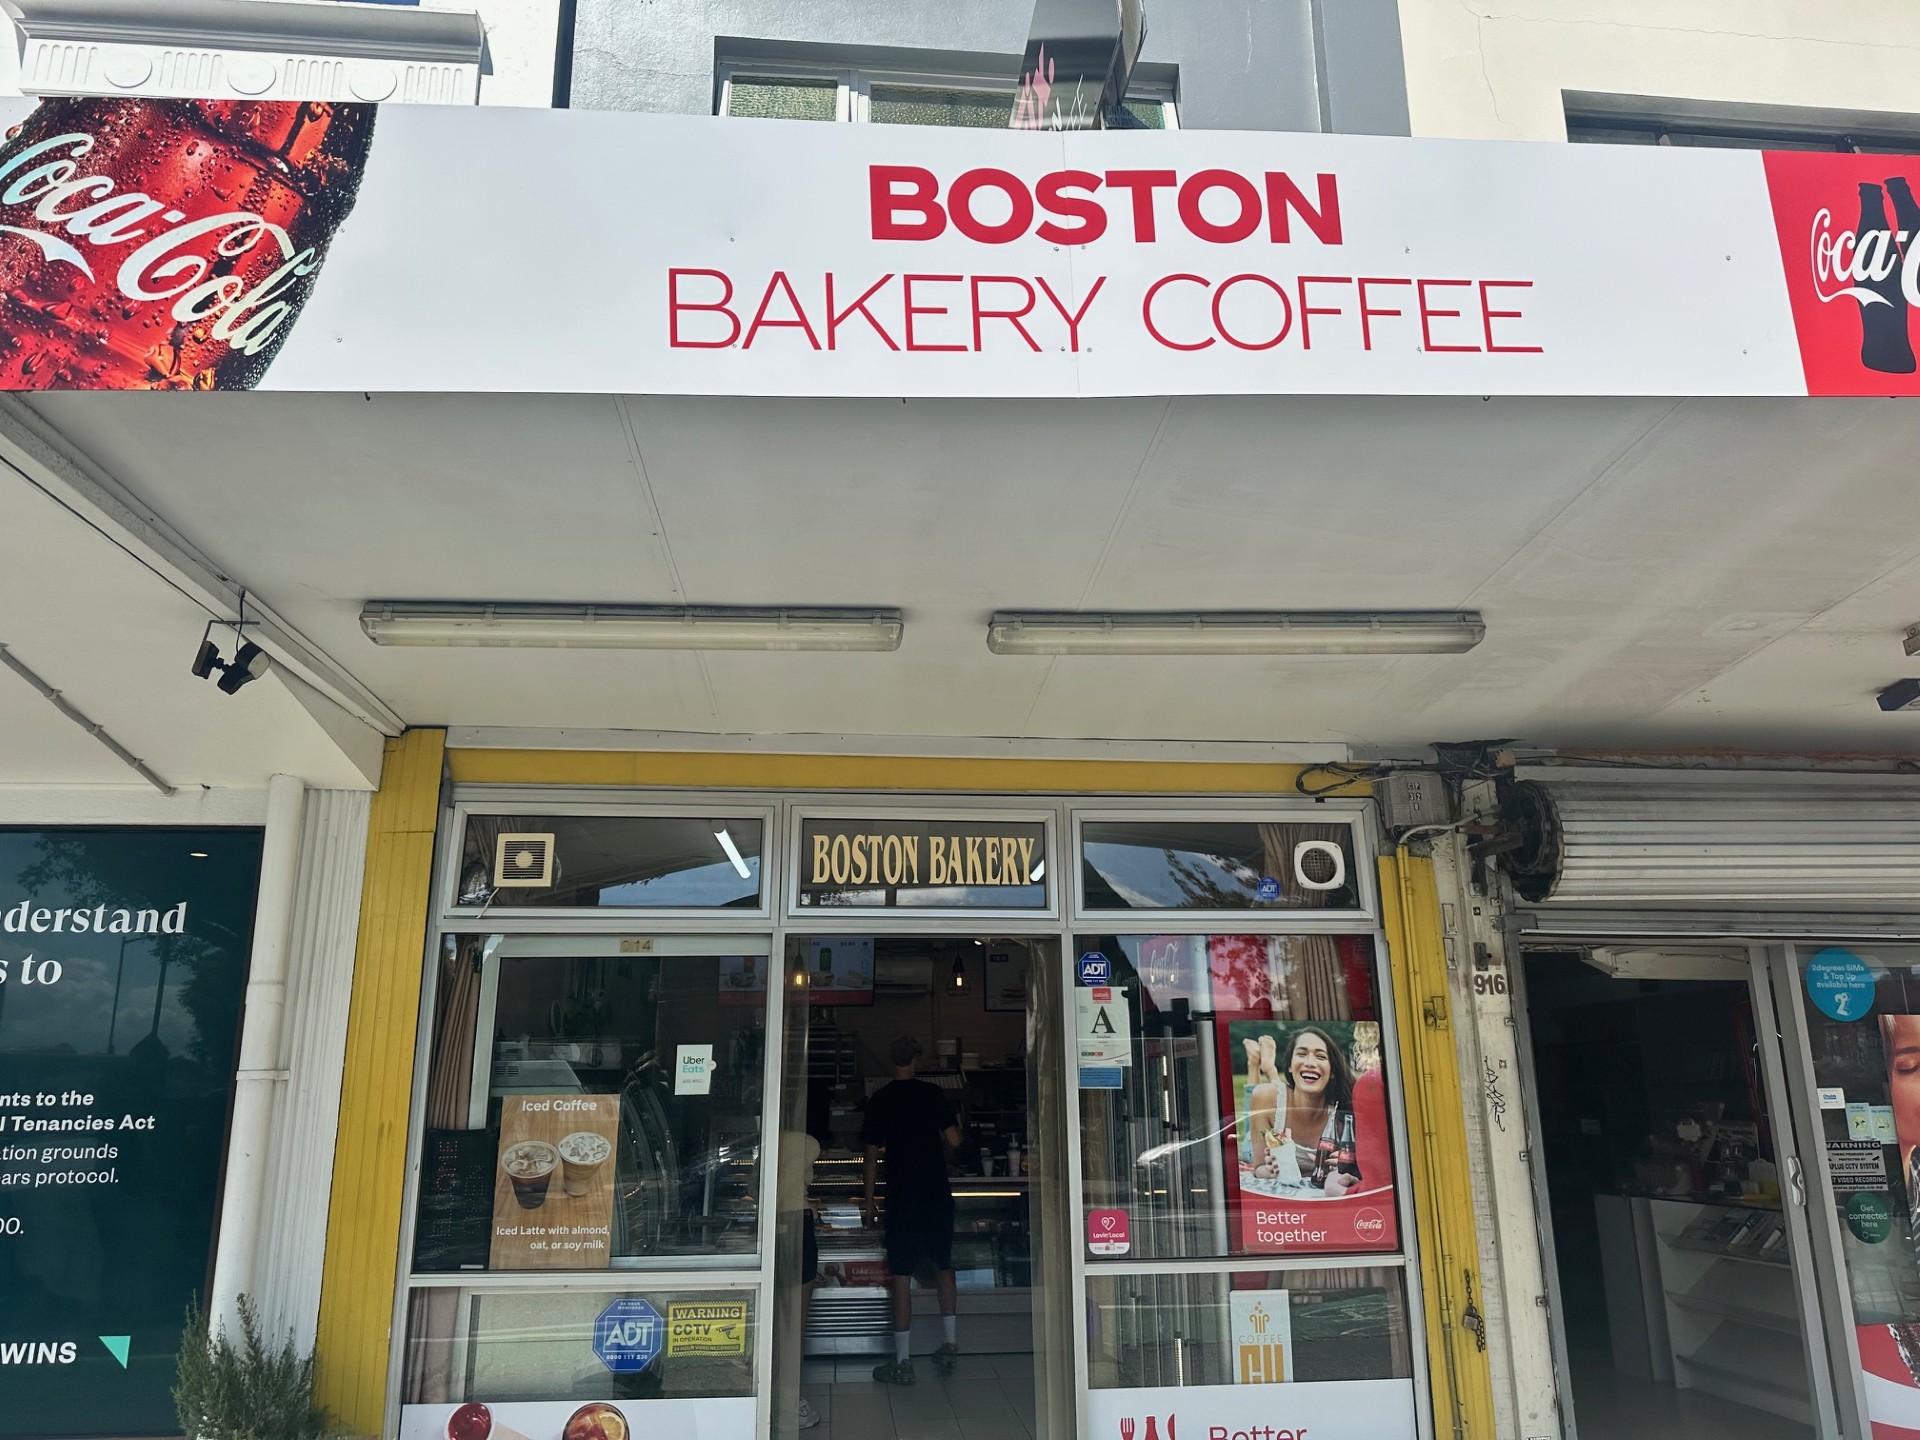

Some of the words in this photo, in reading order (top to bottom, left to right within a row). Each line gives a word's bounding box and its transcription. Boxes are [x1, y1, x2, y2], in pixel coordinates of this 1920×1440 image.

[868, 164, 1343, 246] BOSTON
[0, 132, 318, 356] Coca-Cola
[667, 267, 1107, 352] BAKERY
[1141, 273, 1545, 353] COFFEE
[812, 834, 919, 885] BOSTON
[929, 836, 1035, 886] BAKERY
[1260, 884, 1276, 893] ADT
[0, 900, 187, 934] derstand
[21, 953, 63, 985] to
[1083, 963, 1106, 975] ADT
[1812, 964, 1845, 972] 2degrees
[1830, 973, 1844, 982] Top
[1845, 973, 1856, 981] Up
[1473, 974, 1506, 995] 916
[1090, 1006, 1117, 1034] A
[683, 1056, 705, 1064] Uber
[682, 1065, 704, 1073] Eats
[36, 1092, 56, 1106] to
[61, 1090, 94, 1106] the
[522, 1100, 550, 1112] Iced
[553, 1100, 598, 1112] Coffee
[11, 1115, 115, 1132] Tenancies
[119, 1114, 156, 1130] Act
[0, 1145, 37, 1161] tion
[41, 1143, 118, 1164] grounds
[0, 1172, 31, 1185] ars
[35, 1167, 119, 1188] protocol.
[1860, 1204, 1875, 1212] Get
[1256, 1211, 1307, 1225] Better
[1848, 1212, 1888, 1220] connected
[1861, 1219, 1878, 1228] here
[496, 1226, 517, 1236] Iced
[520, 1226, 545, 1236] Latte
[548, 1226, 569, 1235] with
[571, 1225, 610, 1236] almond,
[1257, 1228, 1327, 1245] together
[529, 1242, 549, 1251] oat,
[563, 1242, 582, 1252] soy
[584, 1240, 605, 1249] milk
[675, 1307, 740, 1320] WARNING
[605, 1321, 653, 1346] ADT
[672, 1323, 711, 1336] CCTV
[679, 1335, 712, 1343] OPERATION
[1238, 1334, 1284, 1345] COFFEE
[0, 1341, 77, 1365] WINS
